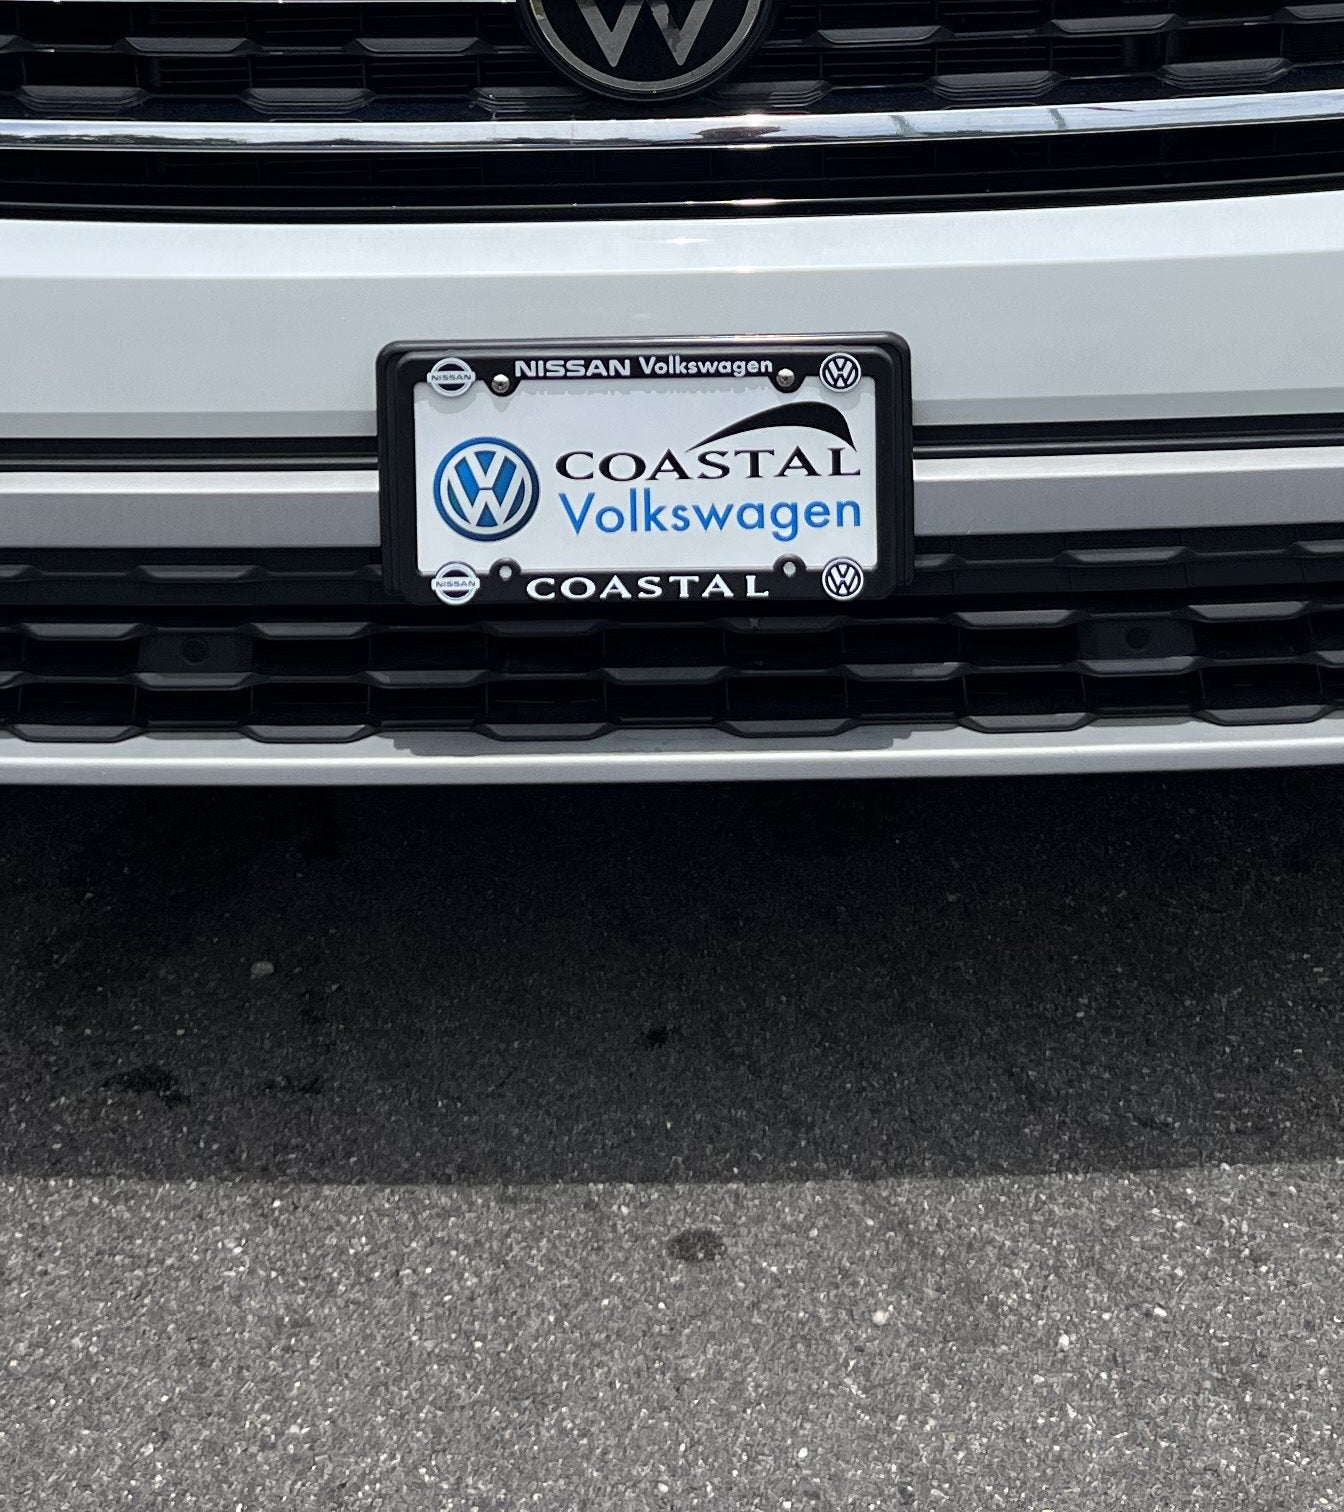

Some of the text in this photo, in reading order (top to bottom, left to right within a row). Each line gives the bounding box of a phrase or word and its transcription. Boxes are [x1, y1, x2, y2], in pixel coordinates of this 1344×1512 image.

[430, 373, 472, 382] NISSAN
[514, 354, 773, 378] NISSAN Volkswagen
[555, 446, 862, 482] COASTAL
[558, 487, 862, 542] Volkswagen
[435, 579, 477, 589] NISSAN
[526, 573, 769, 601] COASTAL
